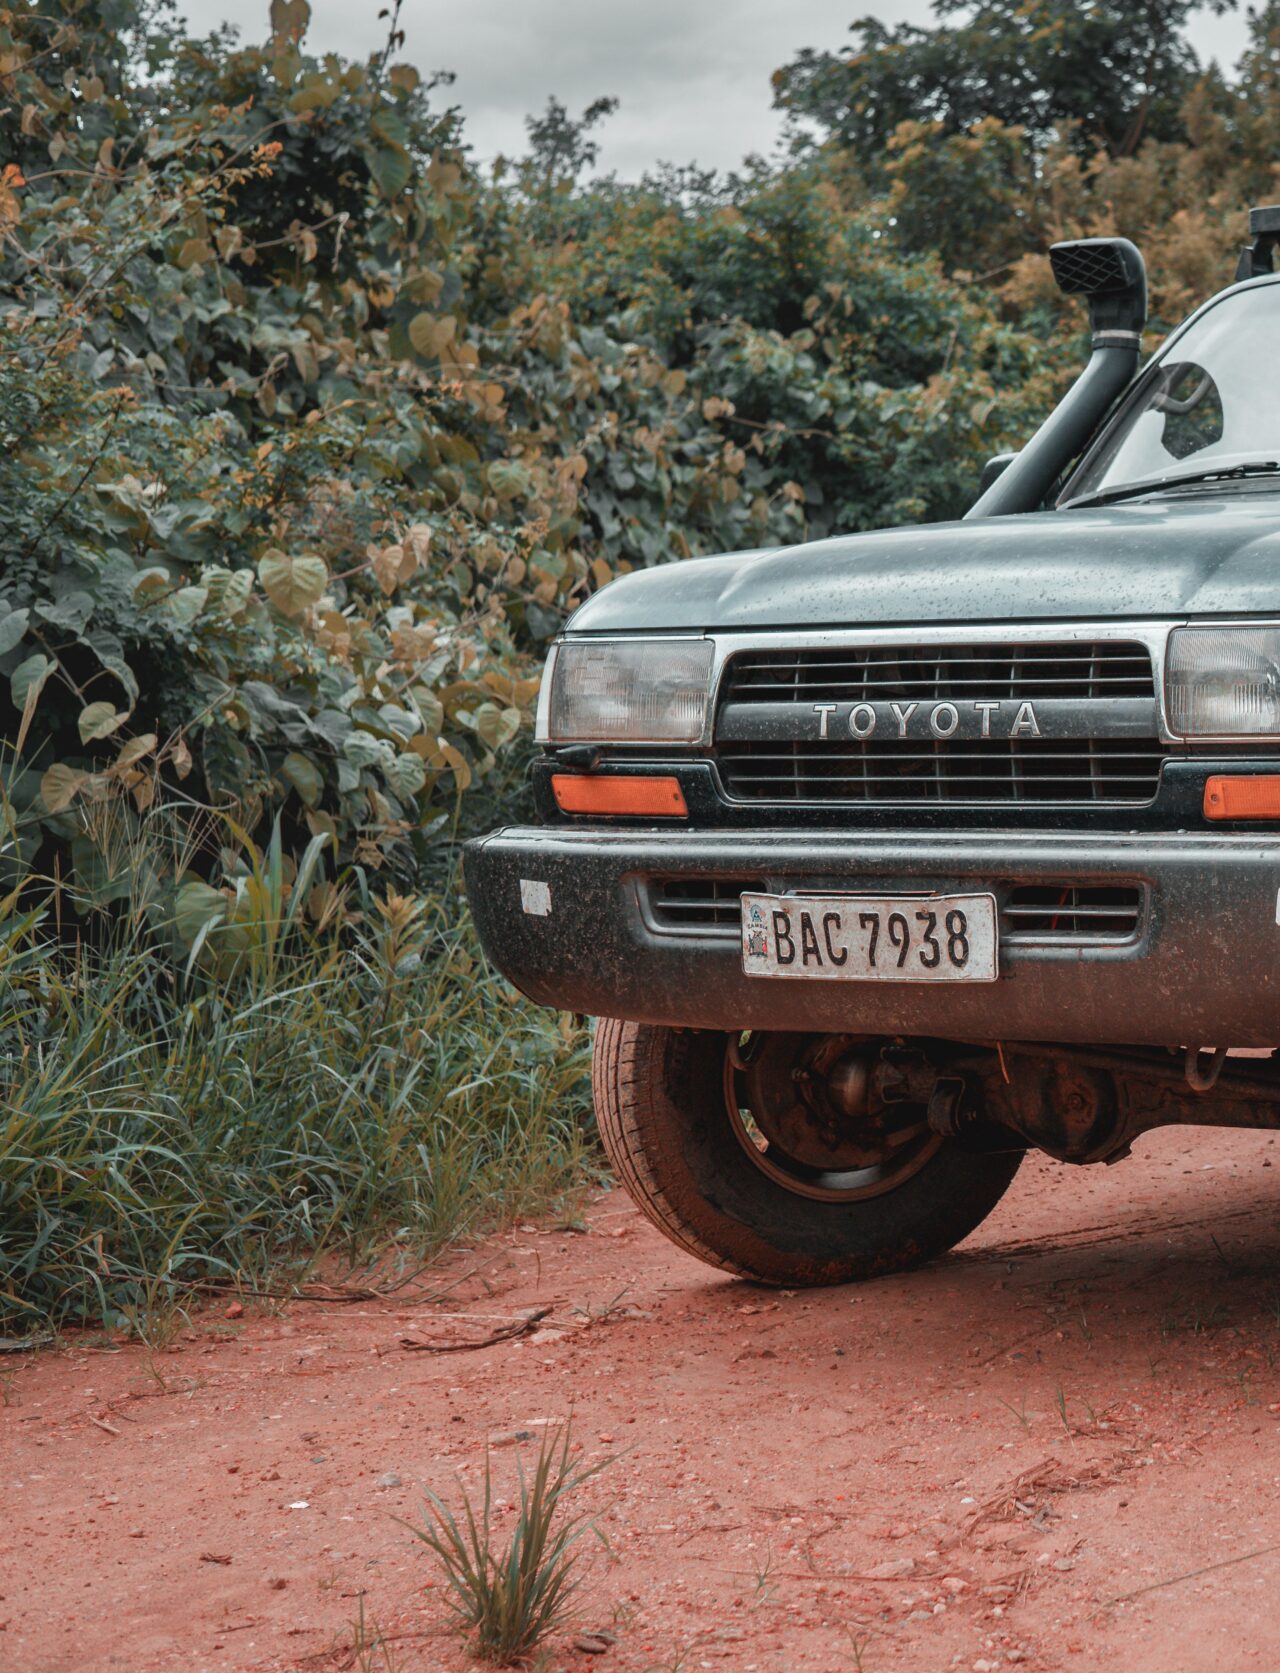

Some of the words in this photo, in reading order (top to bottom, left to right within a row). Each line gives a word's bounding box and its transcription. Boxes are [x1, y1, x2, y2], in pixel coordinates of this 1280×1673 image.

[813, 702, 1041, 740] TOYOTA
[772, 910, 848, 966] BAC
[859, 909, 970, 968] 7938
